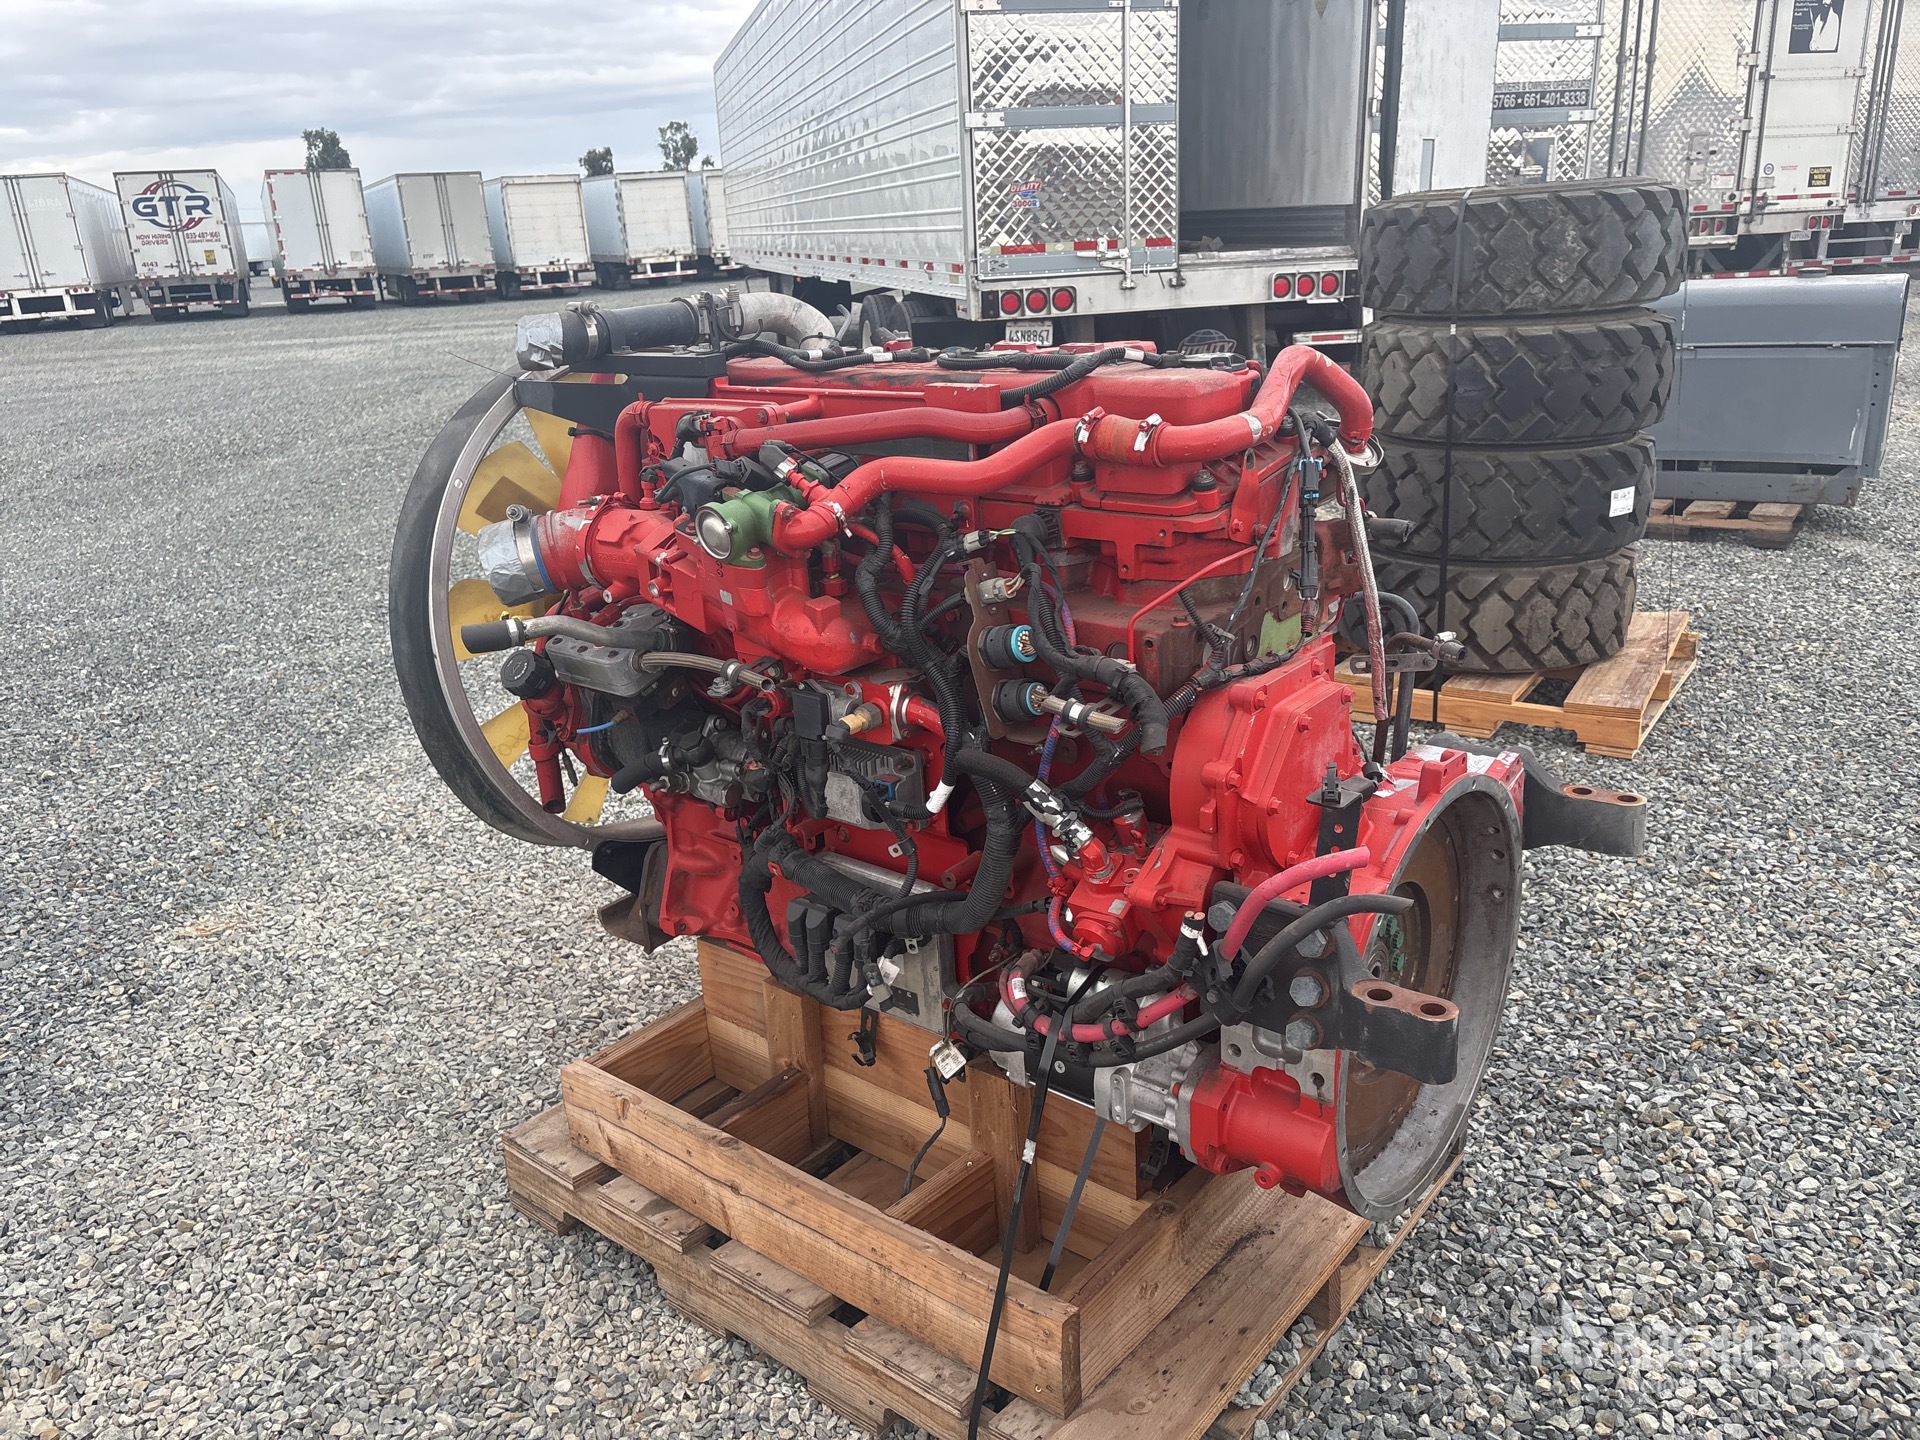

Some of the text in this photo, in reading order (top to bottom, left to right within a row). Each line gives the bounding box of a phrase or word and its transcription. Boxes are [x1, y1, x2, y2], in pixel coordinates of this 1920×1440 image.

[1493, 91, 1587, 108] 5766 661-401-8338
[1010, 182, 1040, 192] UTILITY
[132, 195, 213, 217] GTR
[1012, 199, 1038, 207] 3000R
[1008, 329, 1050, 343] 4SN8867
